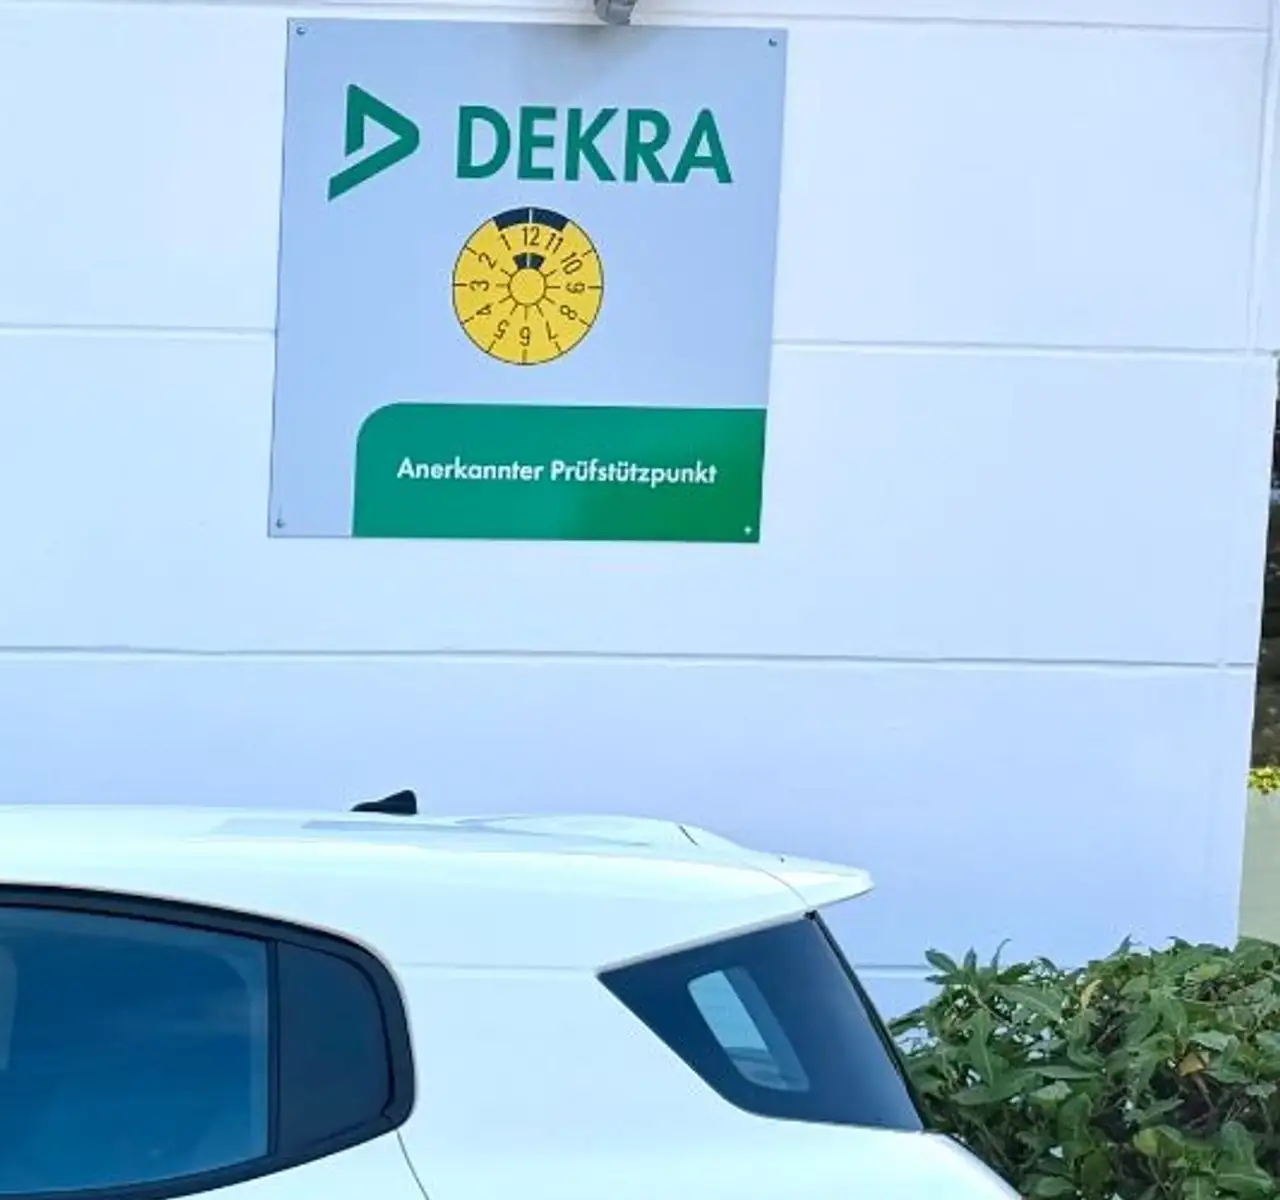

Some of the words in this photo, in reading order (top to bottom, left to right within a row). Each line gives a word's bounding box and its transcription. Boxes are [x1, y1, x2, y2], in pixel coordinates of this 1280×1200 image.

[456, 104, 733, 184] DEKRA
[500, 233, 512, 251] 1
[522, 226, 540, 247] 12
[544, 232, 564, 254] 11
[478, 251, 499, 270] 2
[560, 251, 584, 275] 10
[469, 279, 490, 292] 3
[565, 281, 586, 294] 9
[476, 302, 493, 317] 4
[559, 304, 578, 321] 8
[493, 318, 510, 341] 5
[519, 325, 532, 347] 6
[545, 319, 559, 341] 7
[396, 455, 545, 481] Anerkannter
[550, 458, 718, 489] Prüfstützpunkt
